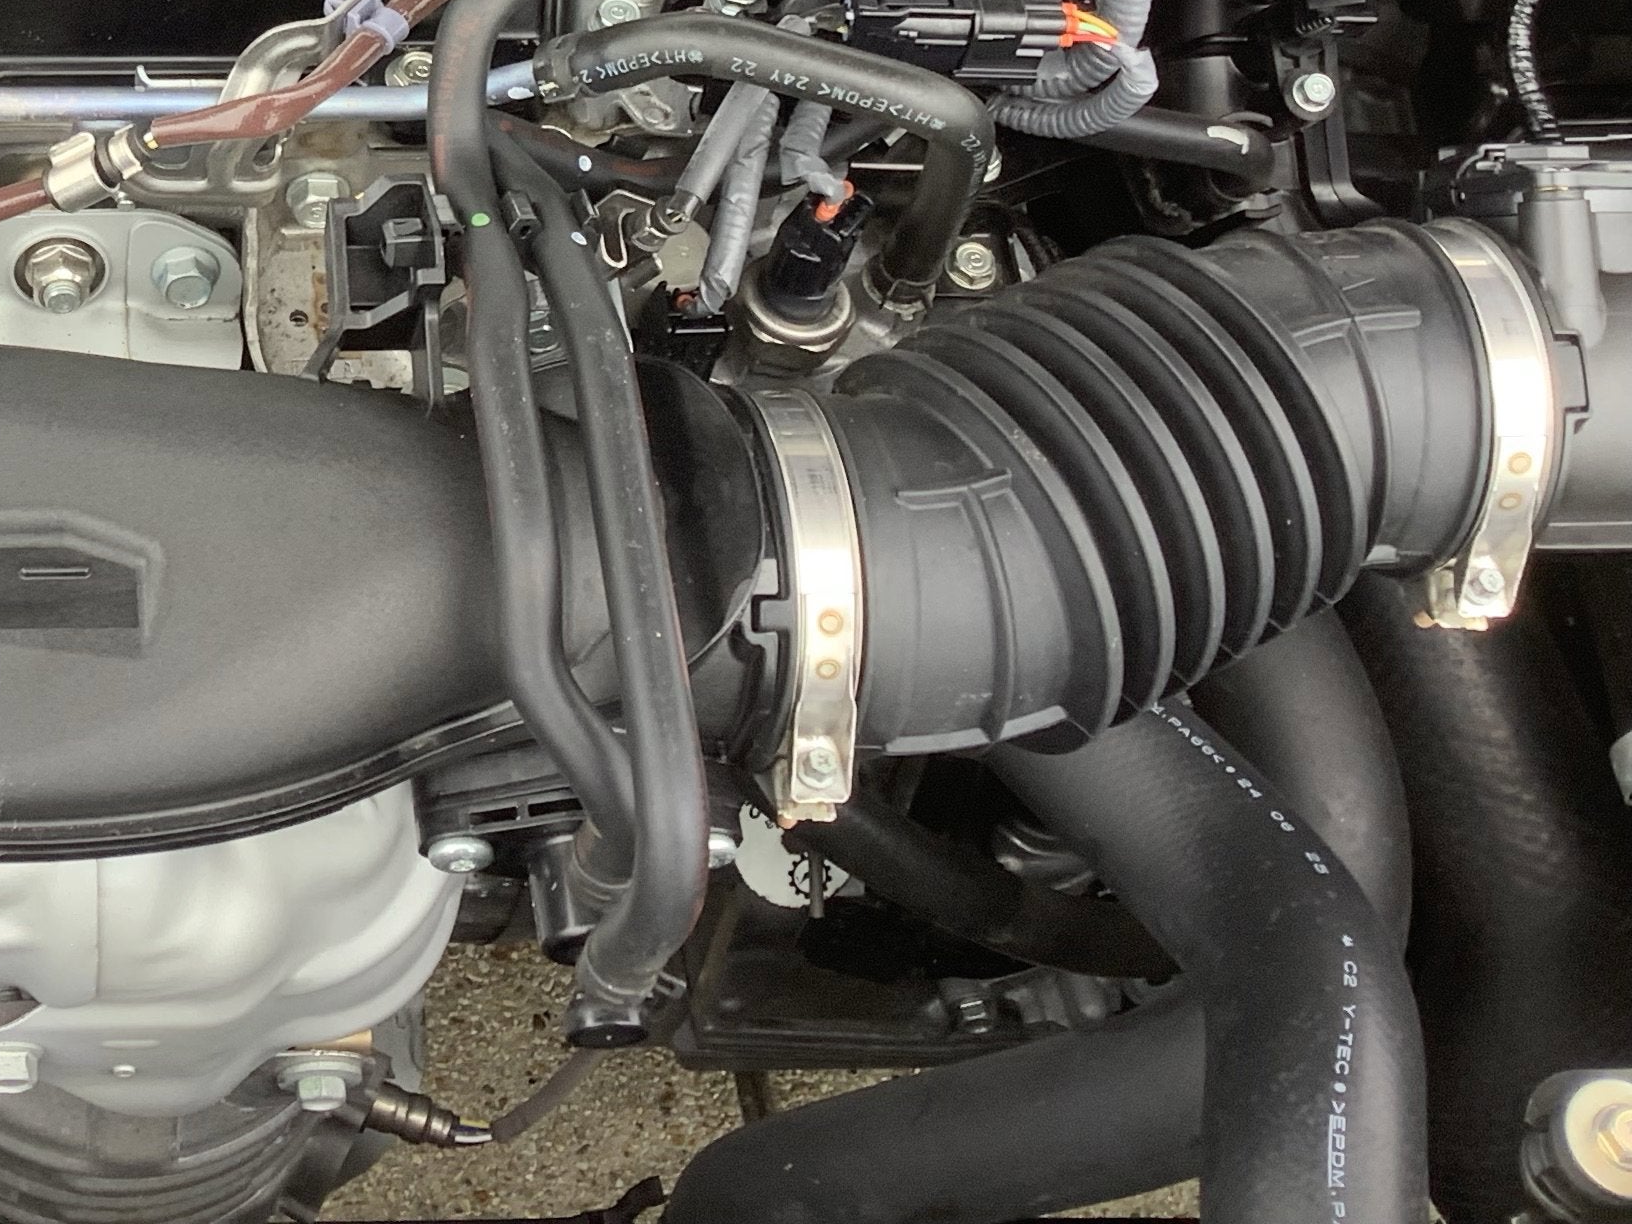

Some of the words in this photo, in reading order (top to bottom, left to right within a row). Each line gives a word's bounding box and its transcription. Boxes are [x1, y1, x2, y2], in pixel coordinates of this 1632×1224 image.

[730, 56, 758, 76] 22
[1342, 960, 1358, 988] C2
[1334, 1004, 1356, 1075] Y-TEC
[1328, 1100, 1346, 1223] >EPDM.P
